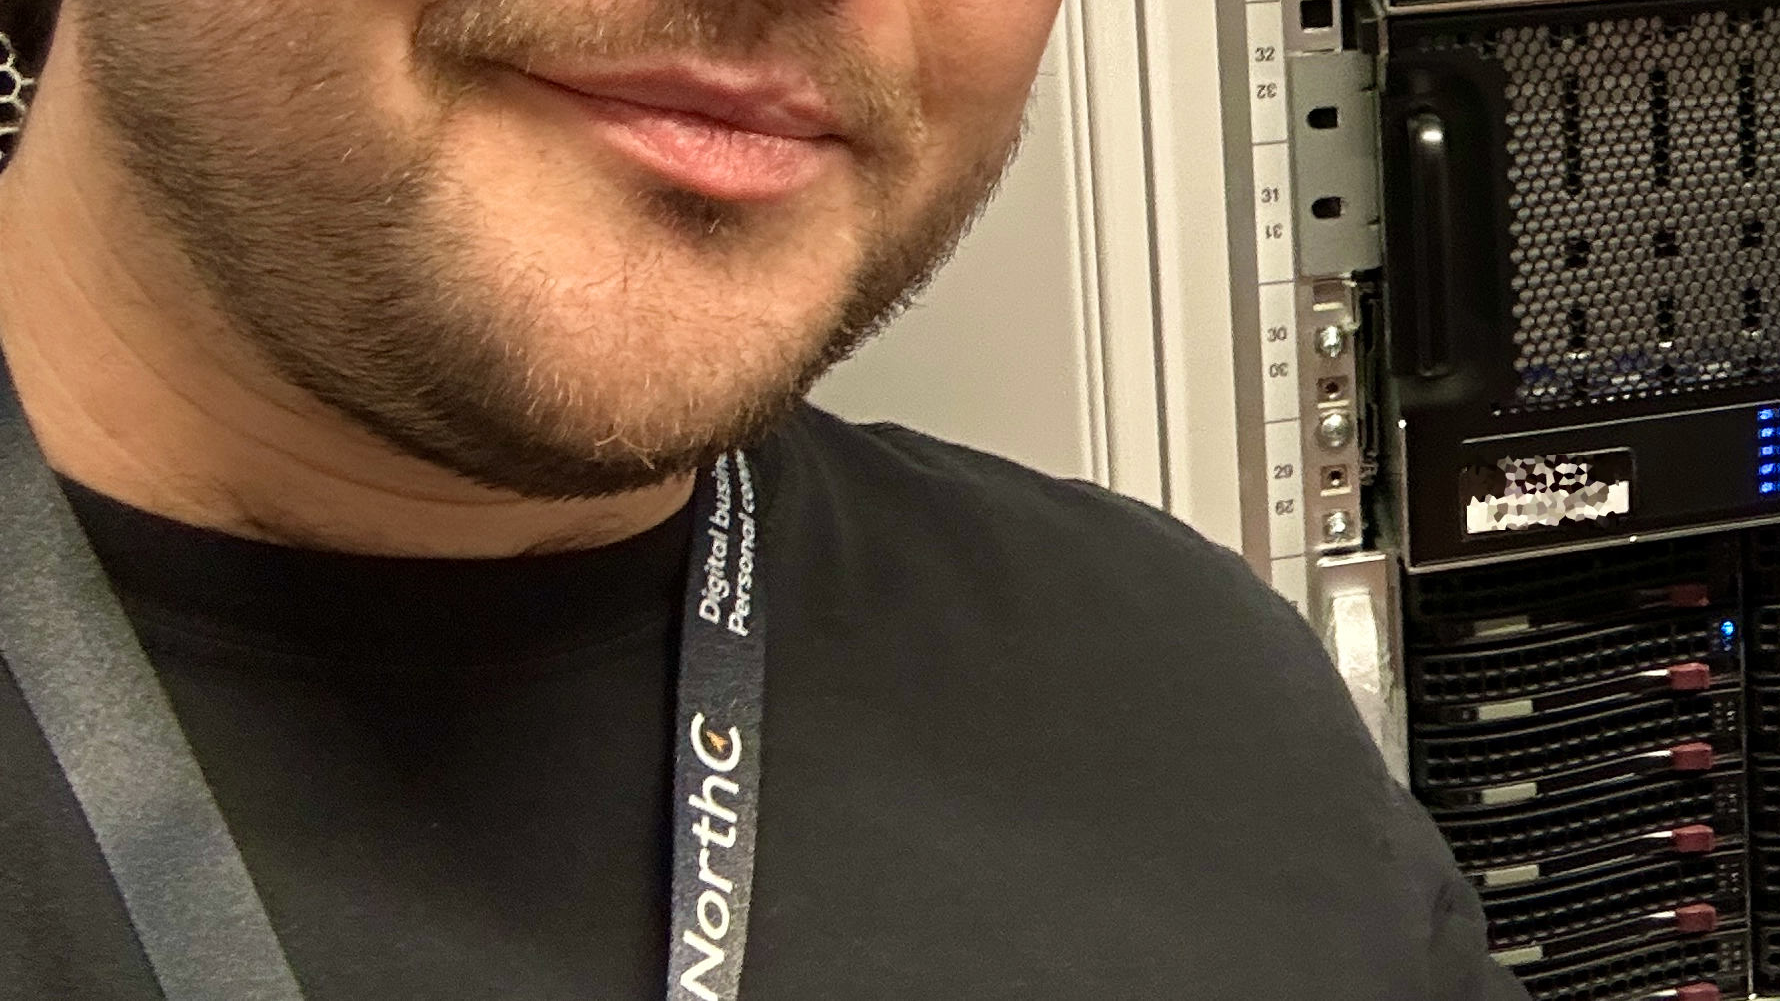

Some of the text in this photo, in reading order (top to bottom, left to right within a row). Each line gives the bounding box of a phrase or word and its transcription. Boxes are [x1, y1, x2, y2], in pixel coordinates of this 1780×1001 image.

[1255, 46, 1276, 62] 32
[1256, 82, 1278, 100] 32
[1260, 186, 1280, 204] 31
[1264, 222, 1284, 240] 31
[1267, 324, 1288, 343] 30
[1269, 362, 1290, 379] 30
[1273, 463, 1294, 480] 29
[1275, 499, 1294, 516] 29
[699, 526, 730, 625] Digital
[727, 511, 756, 637] Personal
[679, 711, 743, 1001] NorthC
